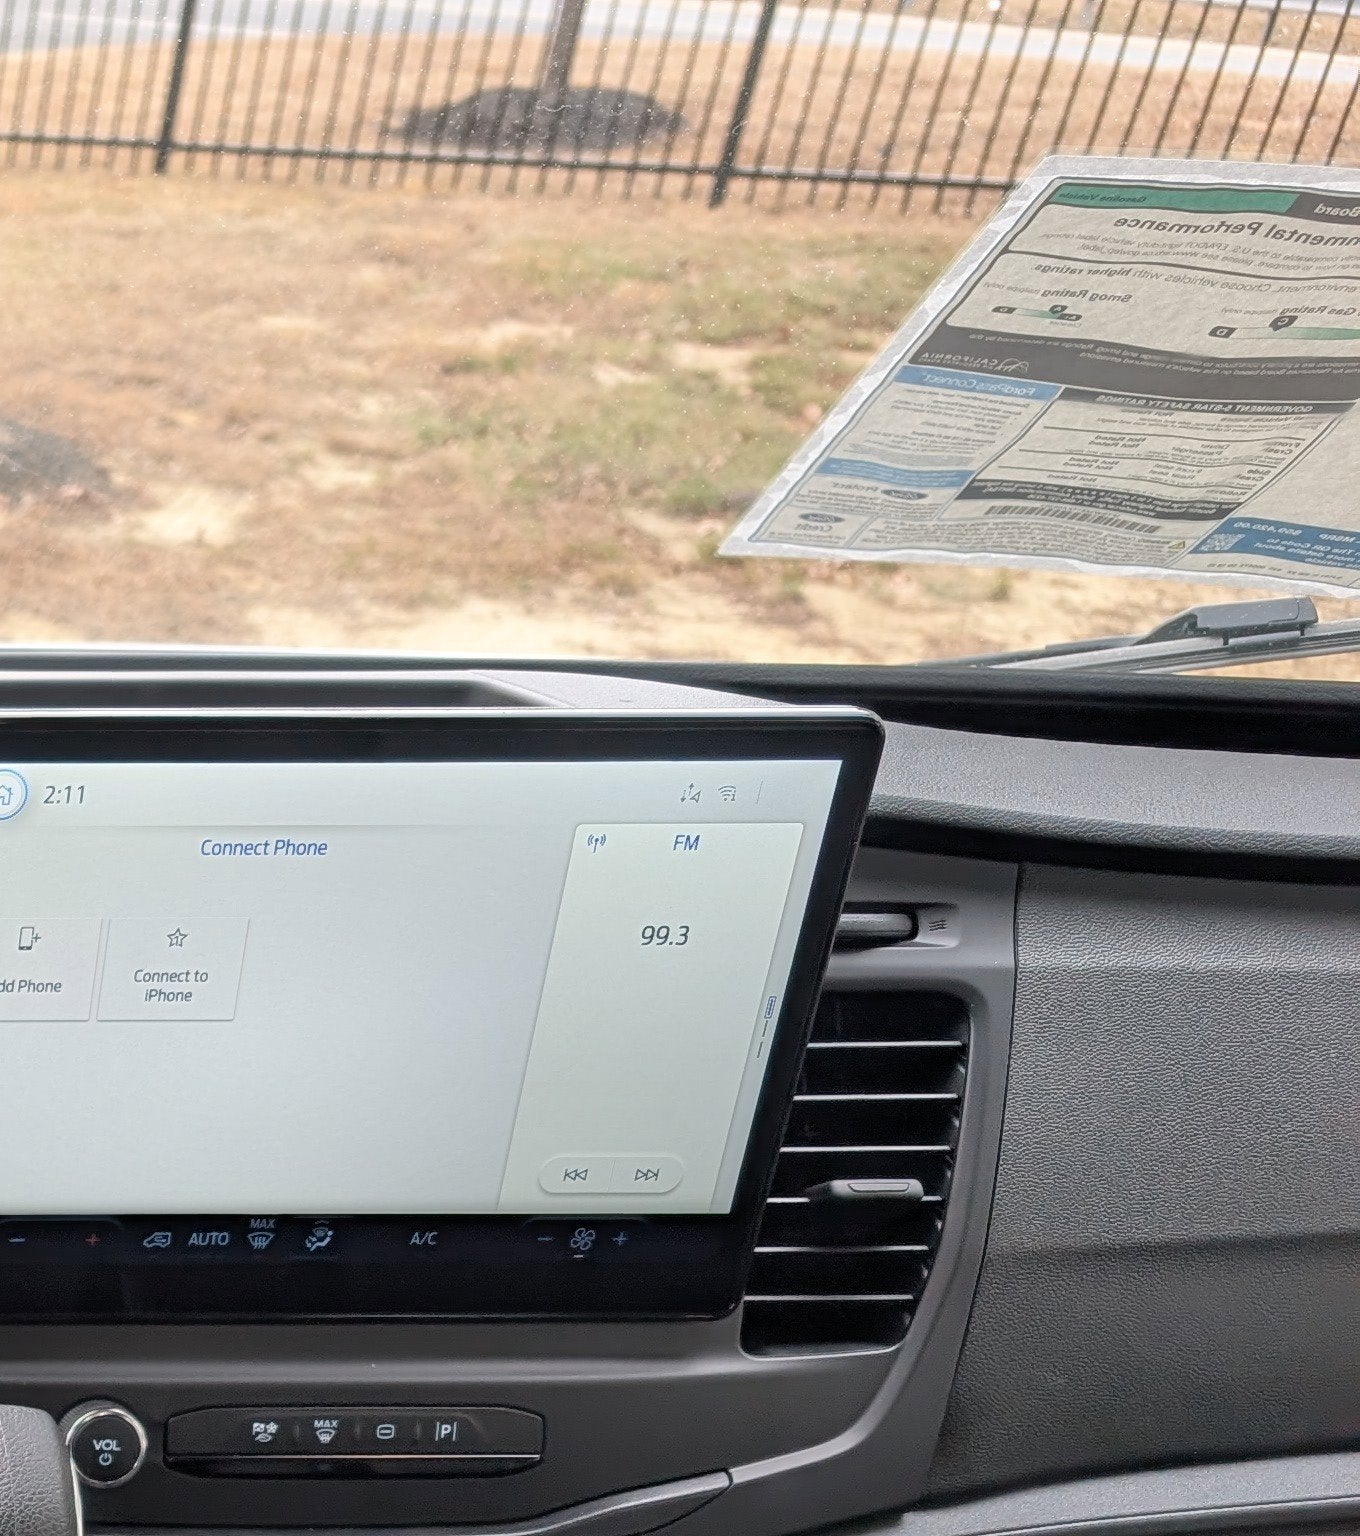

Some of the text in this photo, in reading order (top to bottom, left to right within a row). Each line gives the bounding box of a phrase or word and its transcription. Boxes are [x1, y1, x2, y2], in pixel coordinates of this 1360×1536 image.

[43, 785, 87, 805] 2:11
[200, 838, 329, 856] Connect Phone
[672, 834, 701, 851] FM
[640, 925, 690, 946] 99.3
[133, 968, 209, 984] Connect to
[17, 979, 63, 994] Phone
[143, 988, 193, 1003] iPhone
[249, 1218, 276, 1229] MAX
[188, 1232, 229, 1246] AUTO
[409, 1231, 439, 1246] A/C
[313, 1419, 340, 1429] MAX
[92, 1438, 122, 1451] VOL
